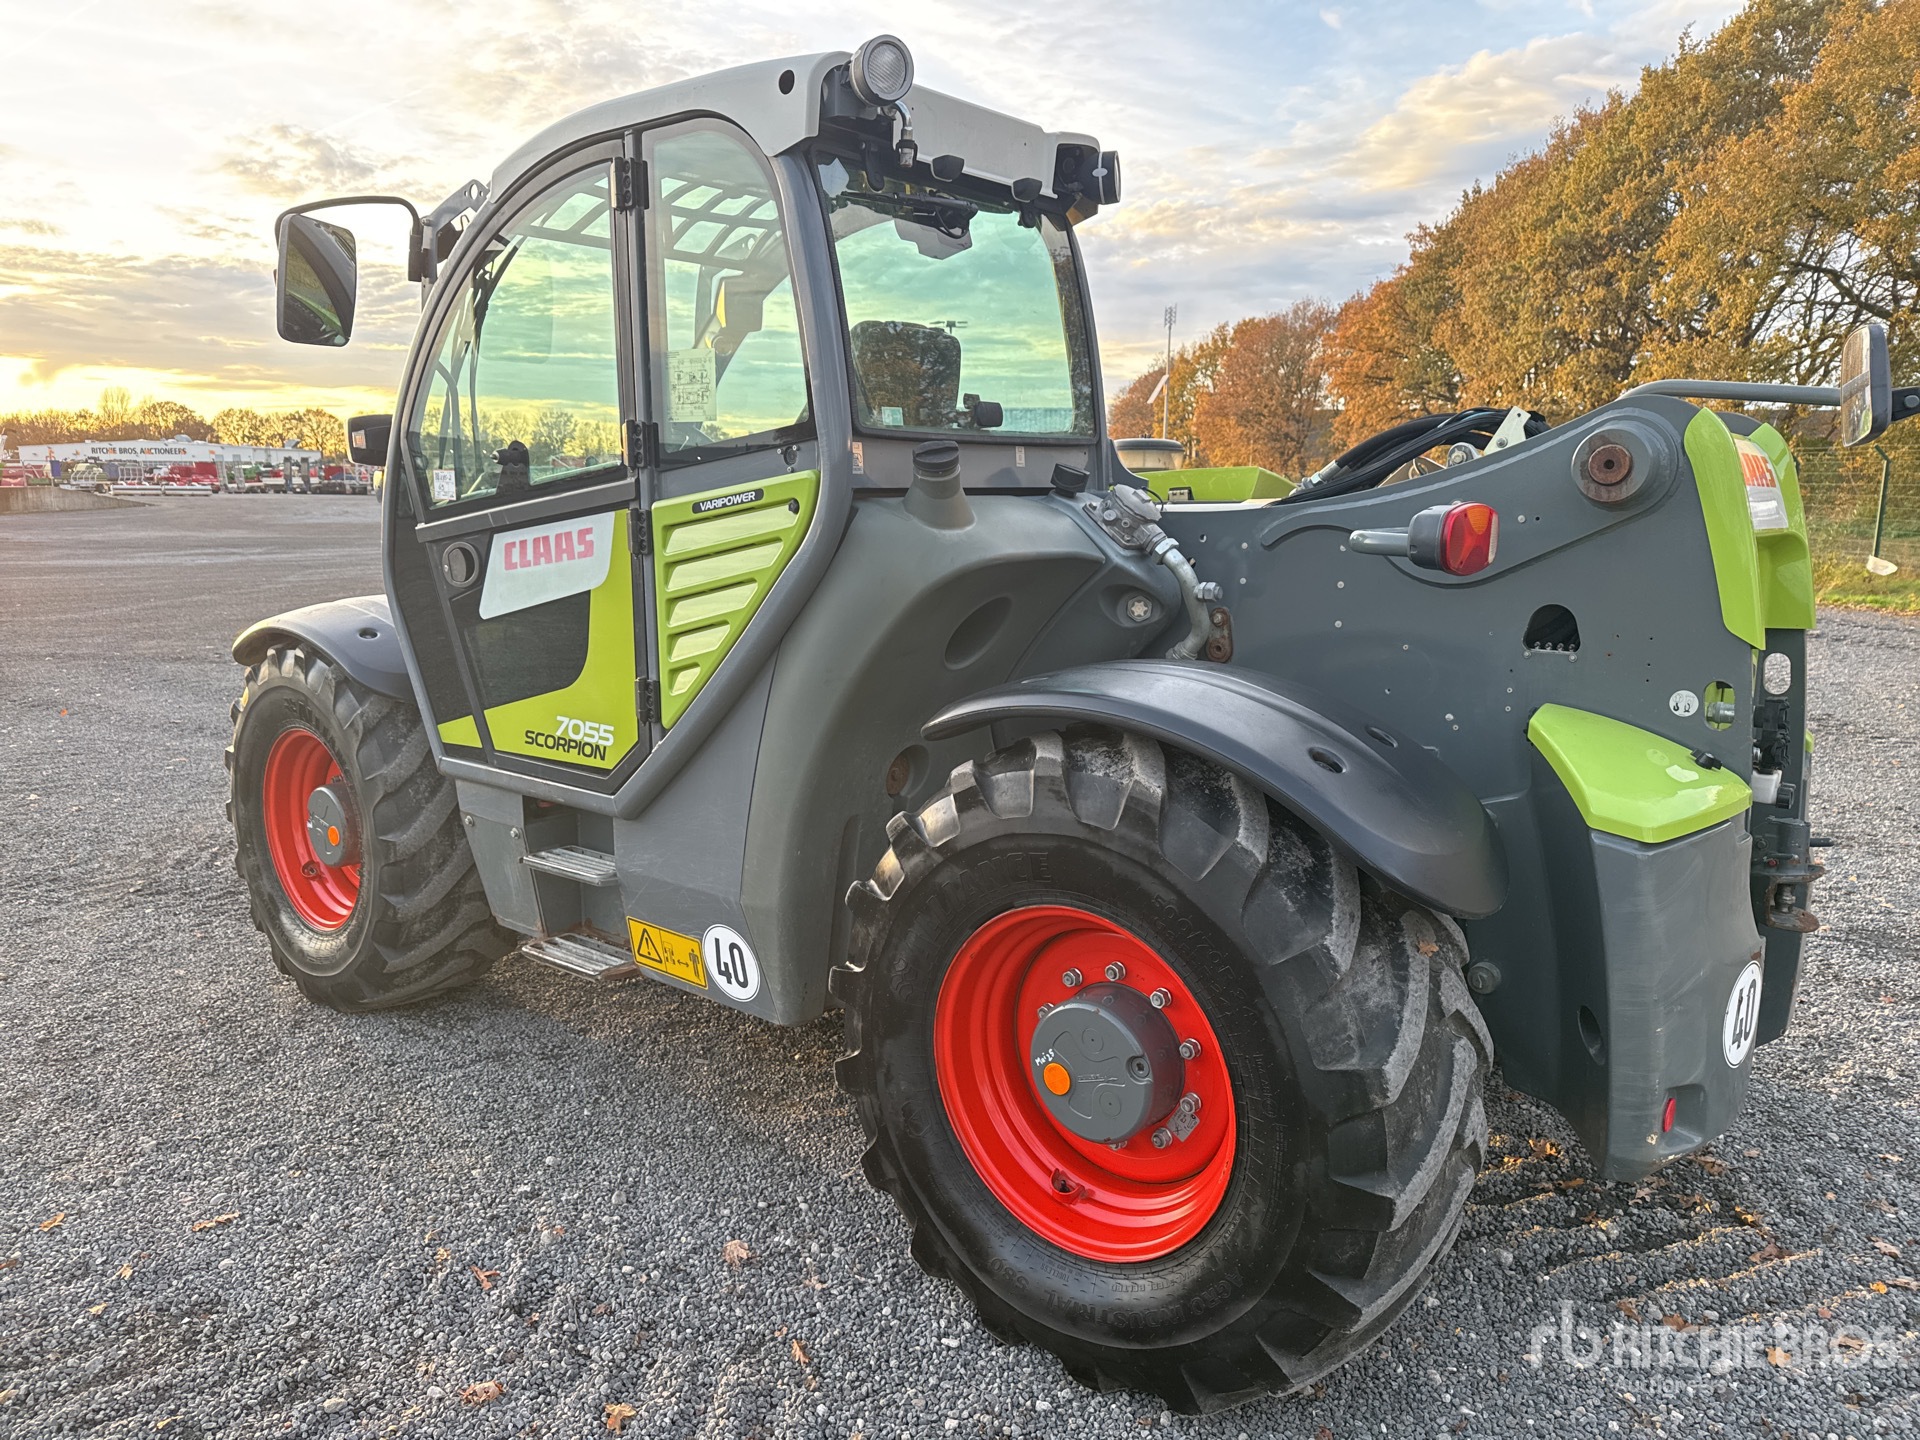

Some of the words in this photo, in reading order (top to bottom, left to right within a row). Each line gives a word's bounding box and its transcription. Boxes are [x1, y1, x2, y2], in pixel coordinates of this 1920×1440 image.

[91, 447, 117, 455] RITCHIE
[118, 447, 138, 455] BROS.
[140, 447, 187, 455] AUCTIONEERS
[699, 491, 756, 511] VARIPOWER
[503, 527, 595, 571] CLAAS
[524, 729, 607, 761] SCORPION
[555, 715, 615, 747] 7055
[714, 937, 749, 989] 40
[1731, 978, 1757, 1050] 40
[1043, 1289, 1186, 1330] INDUSTRIAL
